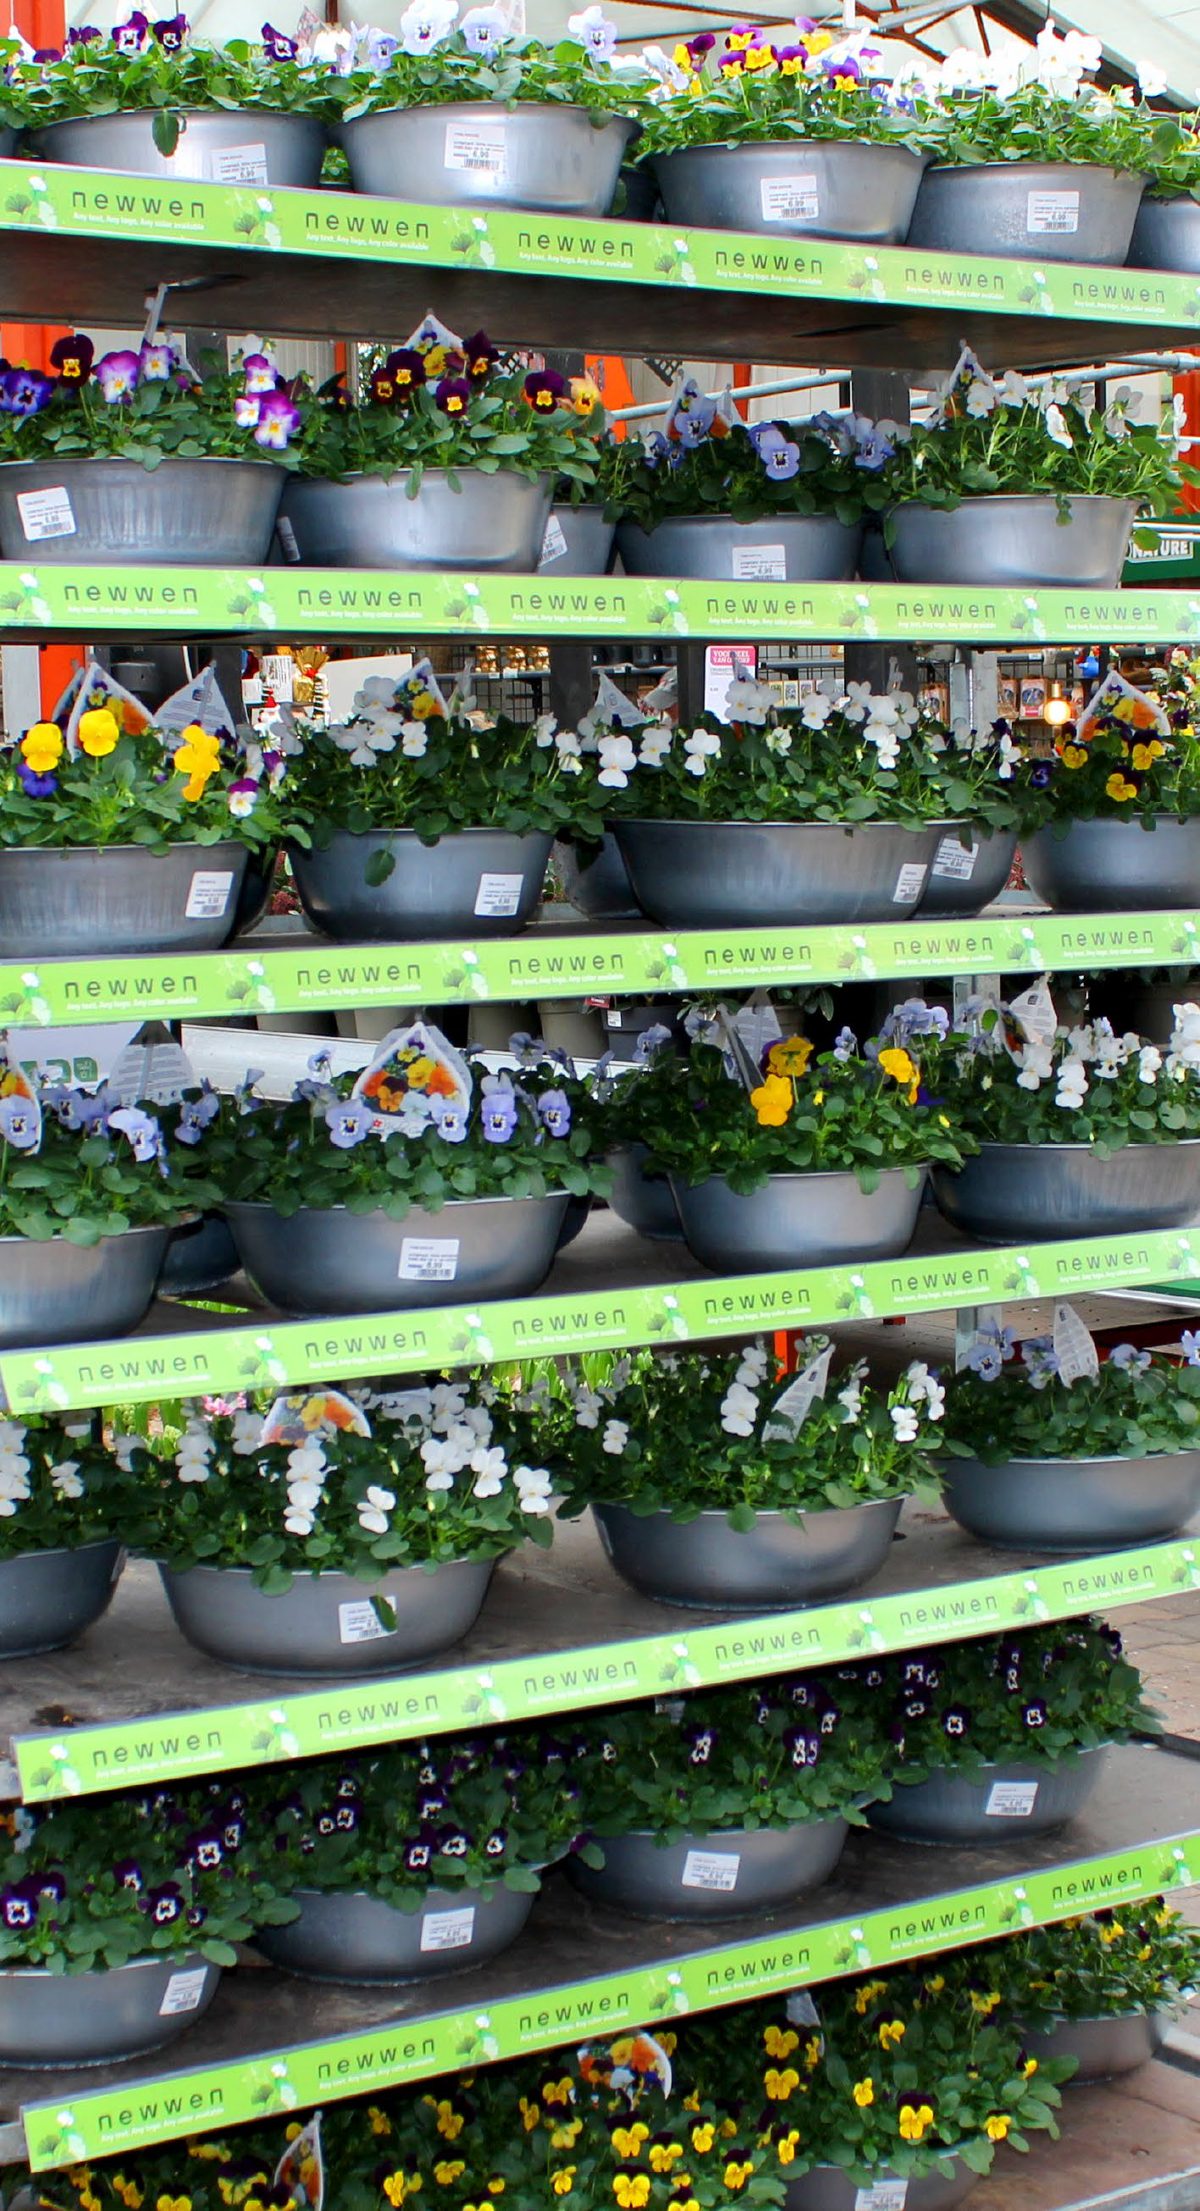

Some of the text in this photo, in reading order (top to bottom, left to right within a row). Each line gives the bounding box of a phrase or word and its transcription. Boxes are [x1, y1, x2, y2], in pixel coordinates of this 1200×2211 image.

[73, 192, 204, 218] newwen
[306, 213, 428, 238] newwen
[519, 233, 633, 257] newwen
[716, 251, 822, 273] newwen
[906, 269, 1003, 289] newwen
[1073, 283, 1164, 302] newwen
[64, 586, 197, 602] newwen
[298, 590, 421, 606] newwen
[511, 595, 625, 611] newwen
[707, 599, 812, 614] newwen
[897, 603, 995, 617] newwen
[1065, 607, 1156, 619] newwen
[894, 937, 992, 954] newwen
[1062, 931, 1152, 947] newwen
[509, 954, 623, 974] newwen
[705, 946, 811, 964] newwen
[65, 976, 196, 998] newwen
[297, 965, 420, 985] newwen
[1057, 1251, 1148, 1272] newwen
[892, 1269, 988, 1292] newwen
[705, 1289, 810, 1314] newwen
[513, 1309, 625, 1334] newwen
[305, 1331, 425, 1357] newwen
[79, 1355, 208, 1381] newwen
[1063, 1565, 1153, 1593] newwen
[900, 1596, 997, 1625] newwen
[715, 1629, 820, 1659] newwen
[525, 1661, 636, 1693] newwen
[319, 1695, 437, 1728] newwen
[93, 1732, 221, 1766] newwen
[1052, 1866, 1141, 1899] newwen
[890, 1905, 984, 1939] newwen
[708, 1949, 808, 1985] newwen
[520, 1993, 627, 2030] newwen
[318, 2039, 434, 2078] newwen
[99, 2088, 223, 2130] newwen
